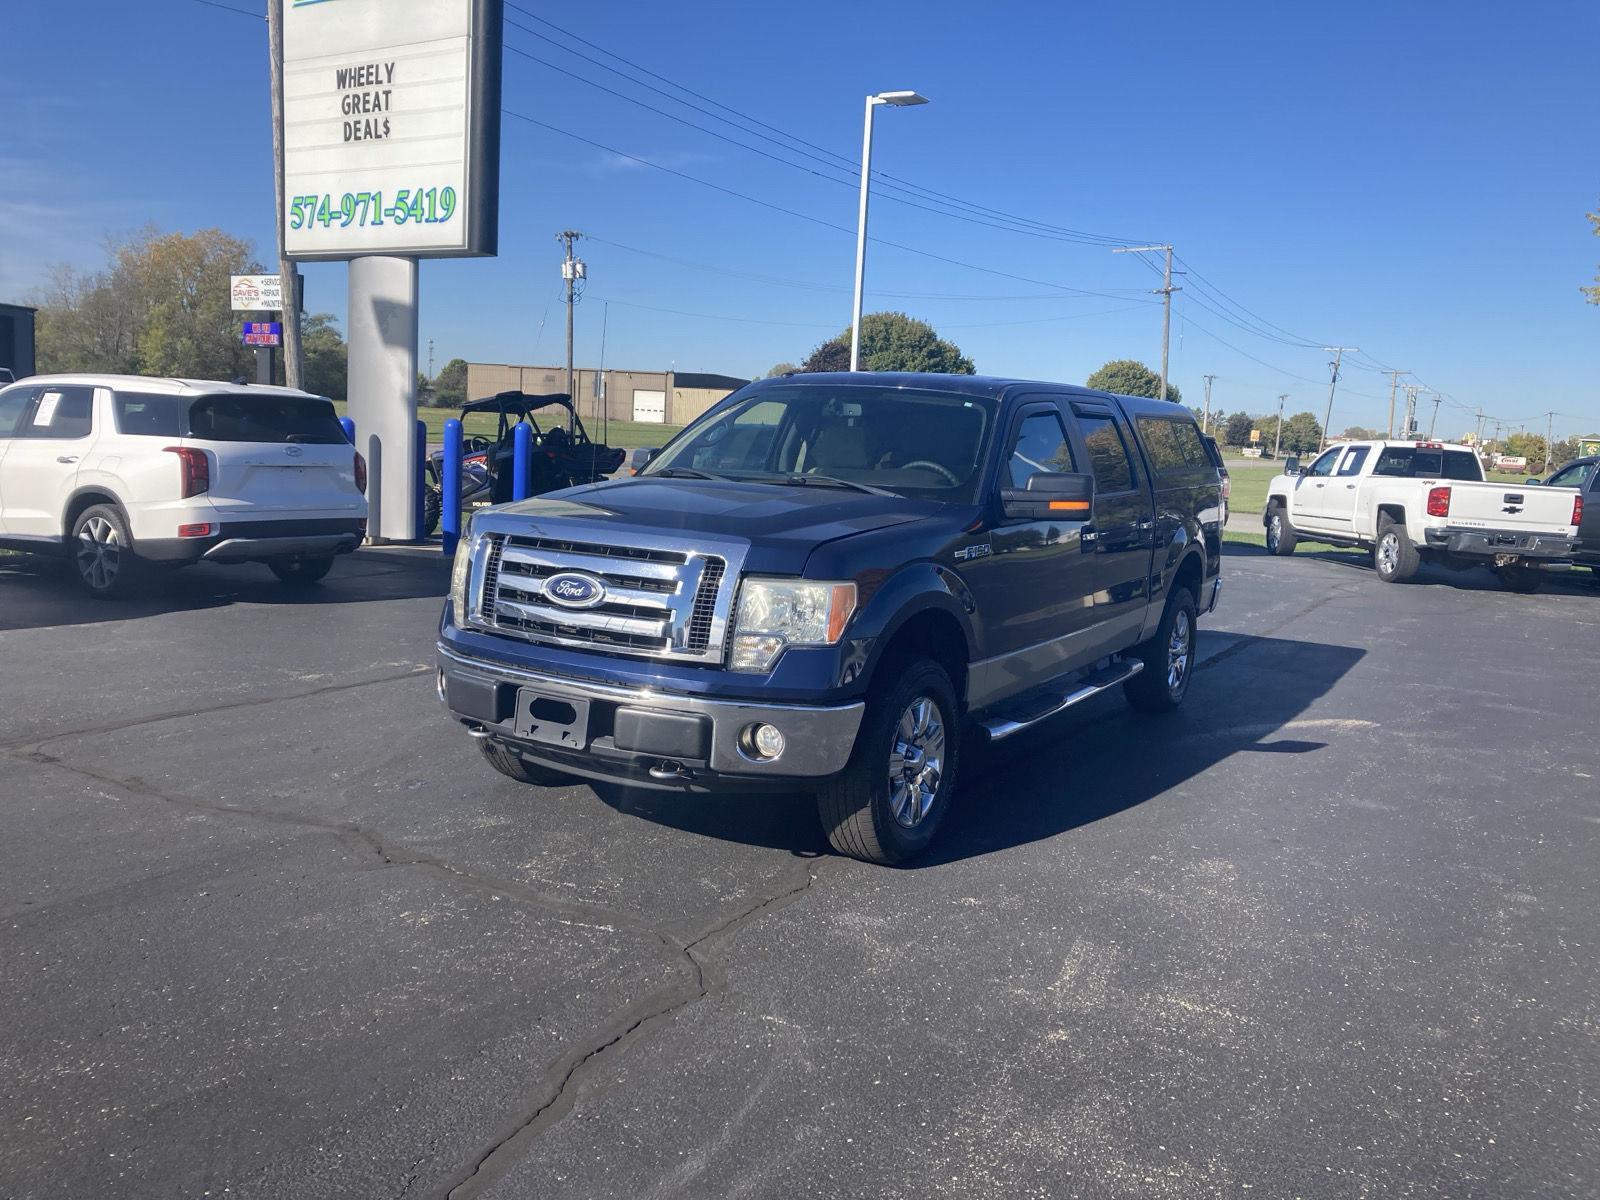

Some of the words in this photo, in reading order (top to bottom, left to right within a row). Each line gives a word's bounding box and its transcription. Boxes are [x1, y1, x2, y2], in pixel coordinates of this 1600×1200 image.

[336, 62, 395, 89] WHEELY
[341, 90, 392, 115] GREAT
[343, 118, 390, 142] DEAL$
[290, 186, 456, 229] 574-971-5419
[556, 580, 585, 596] Ford
